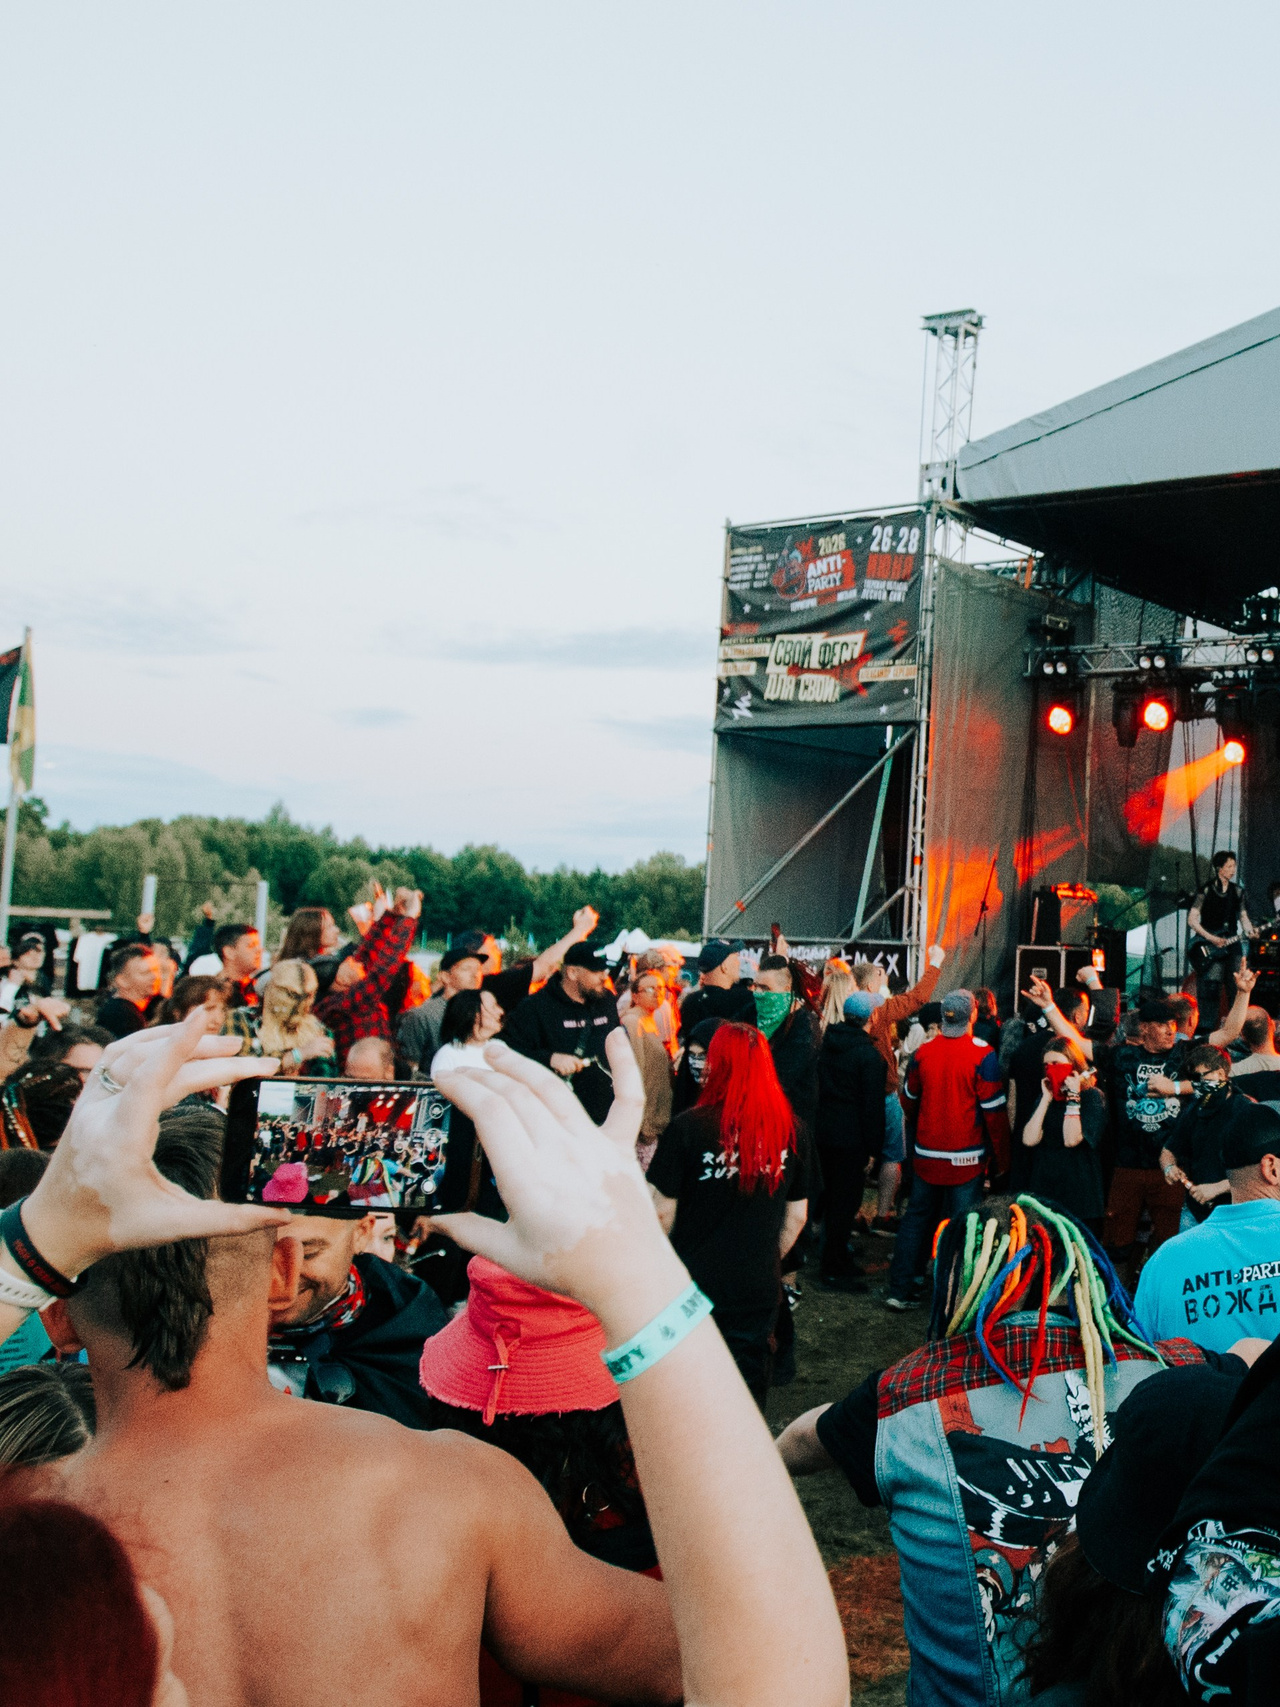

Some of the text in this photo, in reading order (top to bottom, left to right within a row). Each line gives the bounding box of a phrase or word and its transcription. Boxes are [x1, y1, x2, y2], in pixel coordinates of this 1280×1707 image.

[818, 533, 846, 556] 2026
[870, 526, 920, 554] 26-28
[807, 571, 842, 593] PARTY
[774, 636, 858, 668] СВОЙ ФЕСТ
[764, 673, 796, 701] ДЛЯ
